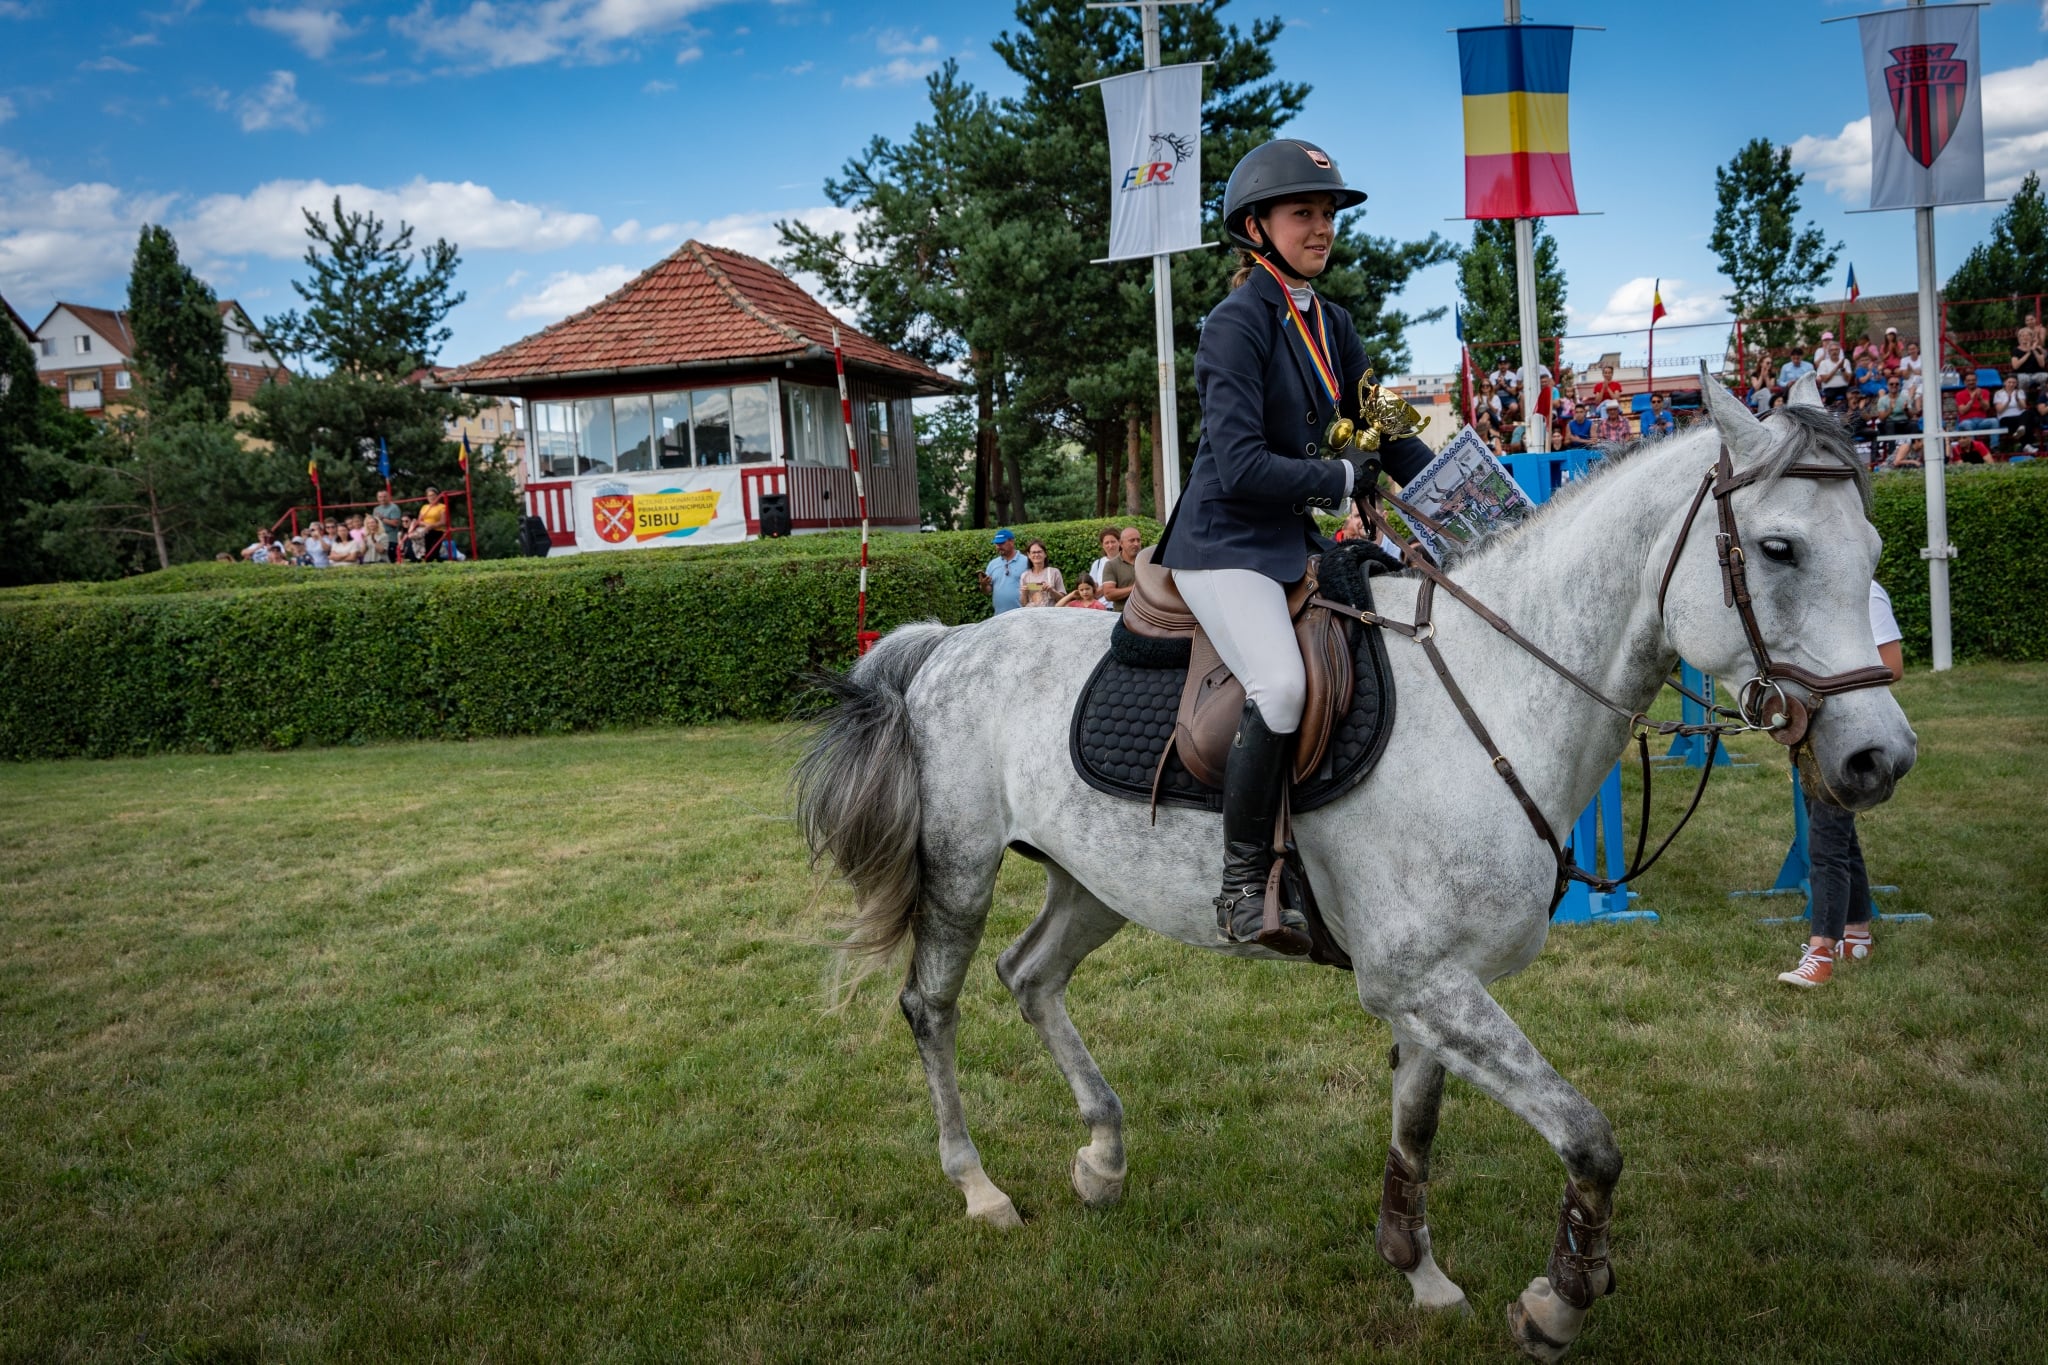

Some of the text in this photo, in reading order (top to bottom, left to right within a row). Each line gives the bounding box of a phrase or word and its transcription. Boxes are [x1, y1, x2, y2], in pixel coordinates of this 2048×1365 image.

[1902, 47, 1946, 60] CSM
[1893, 65, 1958, 84] SIBIU
[1121, 162, 1173, 188] FER
[670, 503, 713, 511] MUNICIPIULUI
[639, 512, 680, 528] SIBIU
